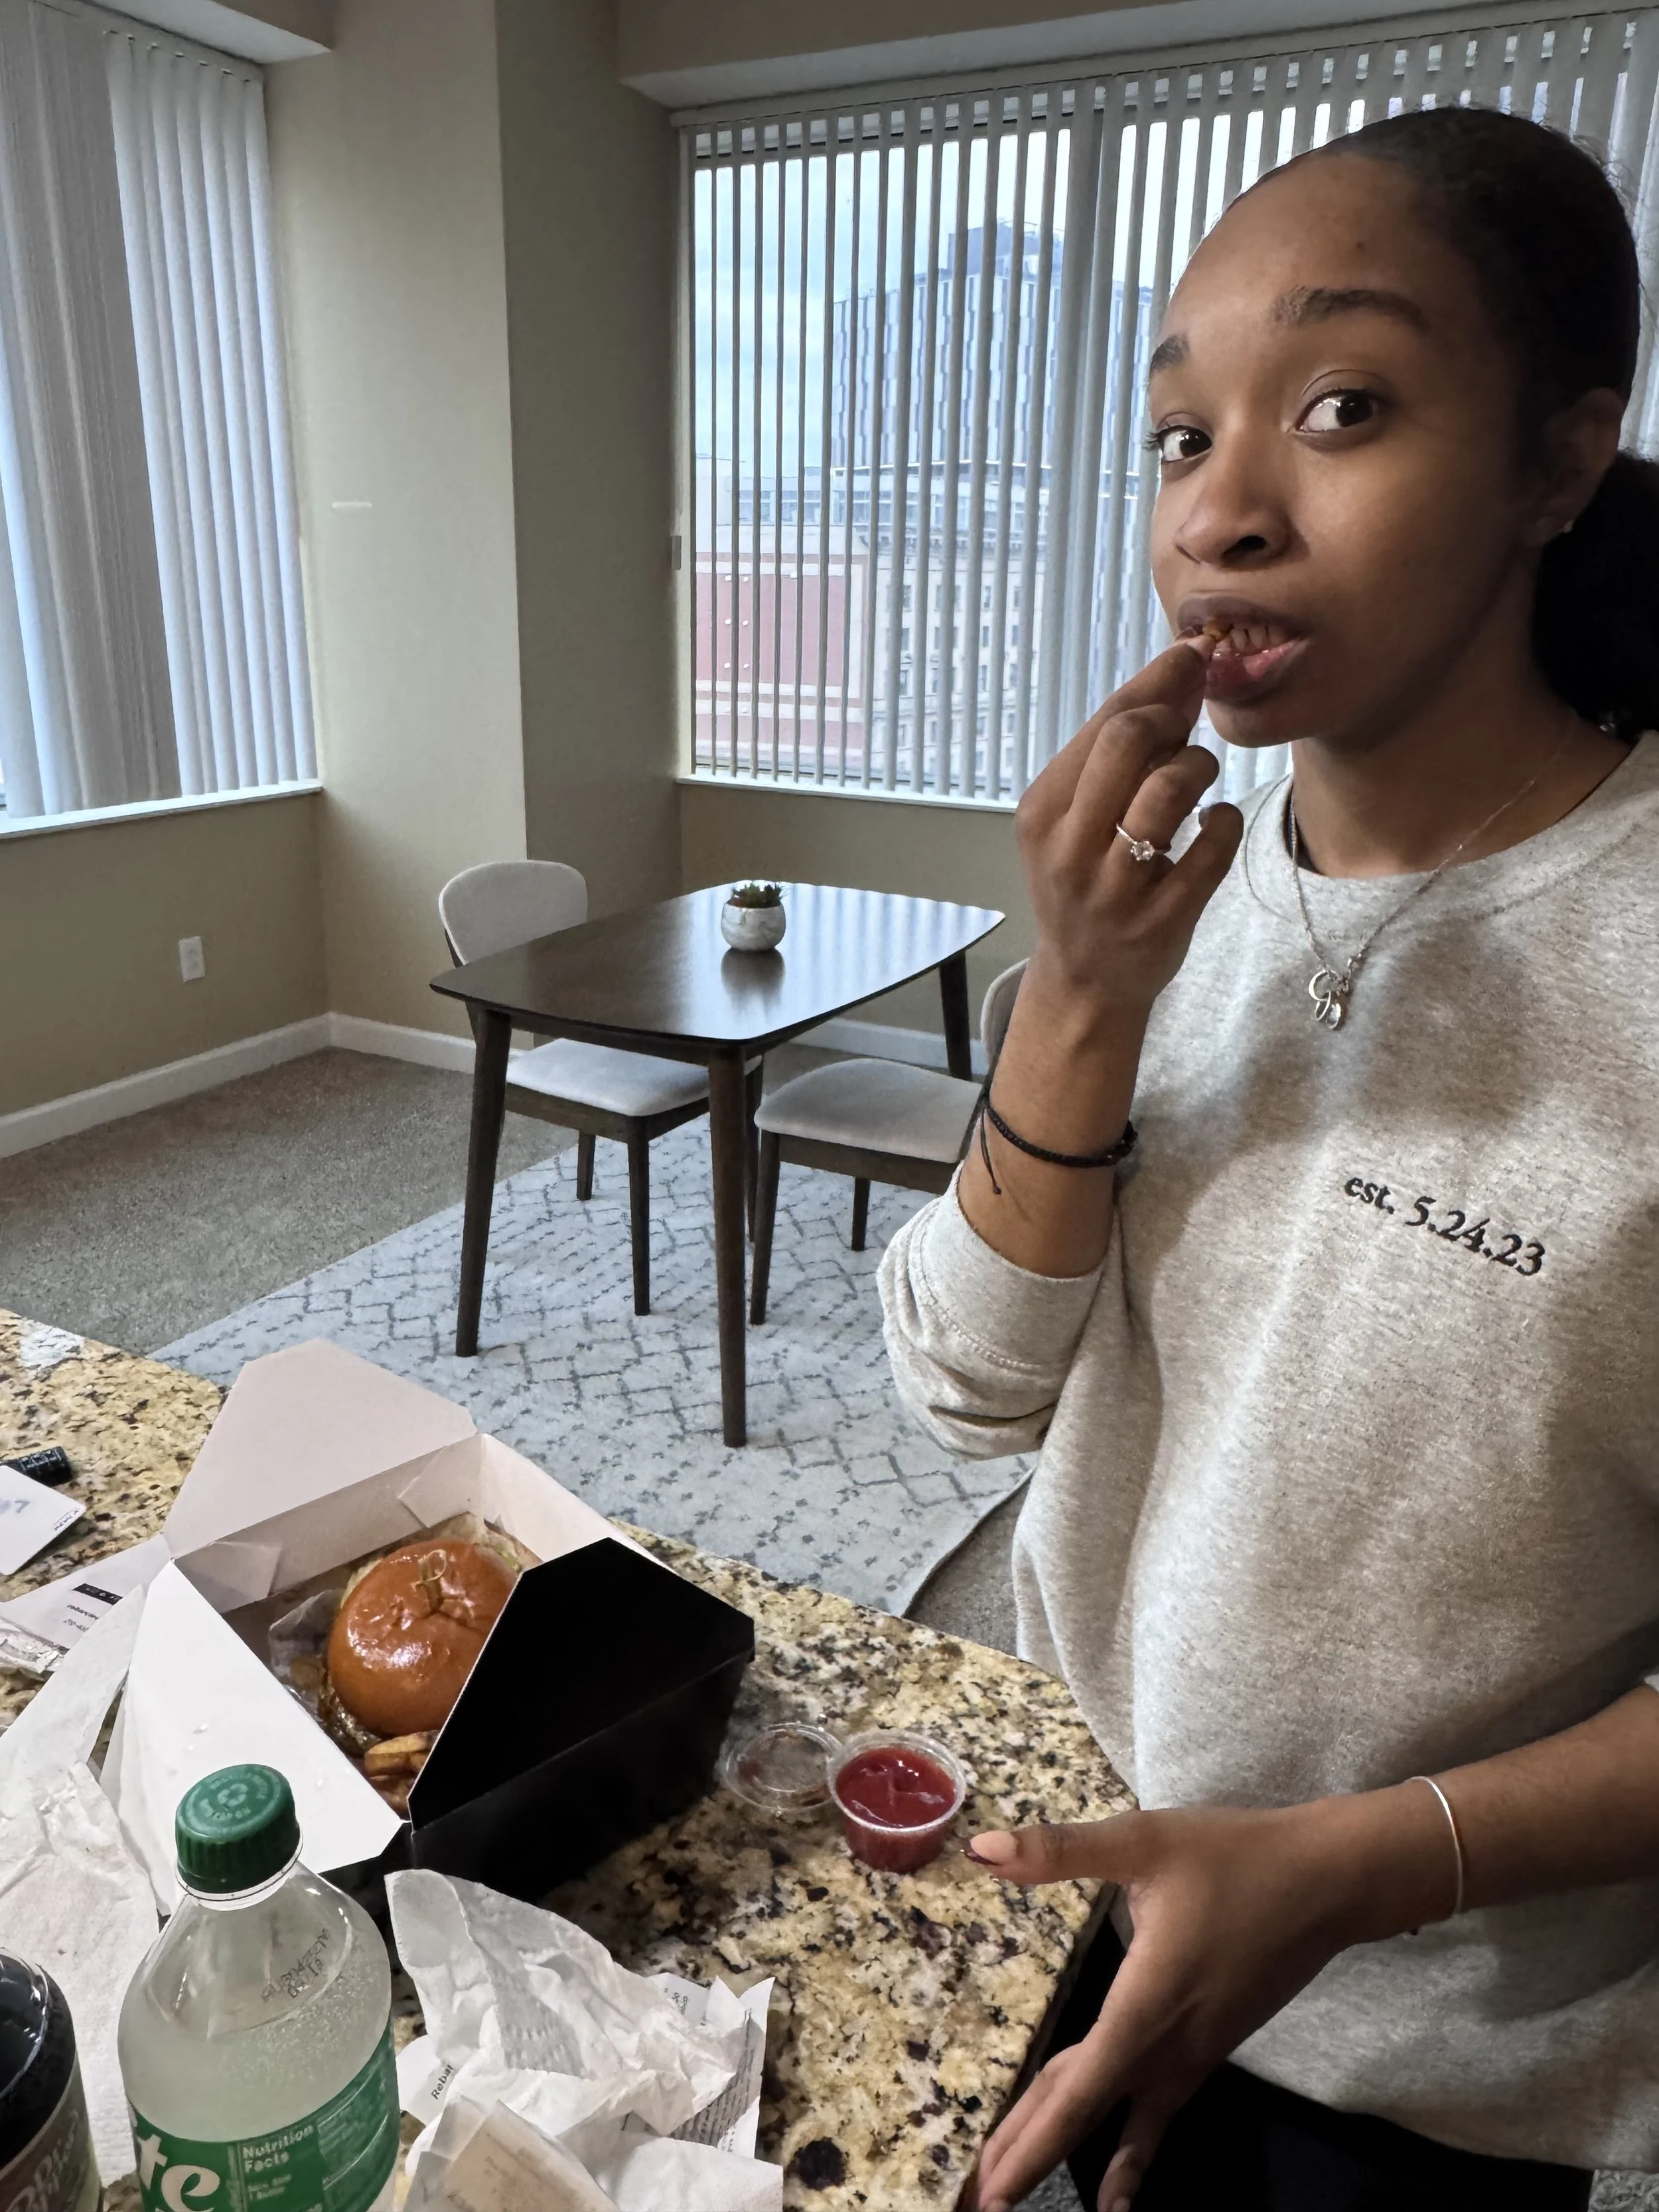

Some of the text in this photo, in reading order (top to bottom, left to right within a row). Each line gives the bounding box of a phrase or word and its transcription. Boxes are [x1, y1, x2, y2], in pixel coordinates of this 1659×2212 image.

[1344, 1177, 1545, 1276] est. 5.24.23
[131, 2116, 220, 2212] te
[242, 2124, 315, 2158] Nutrition
